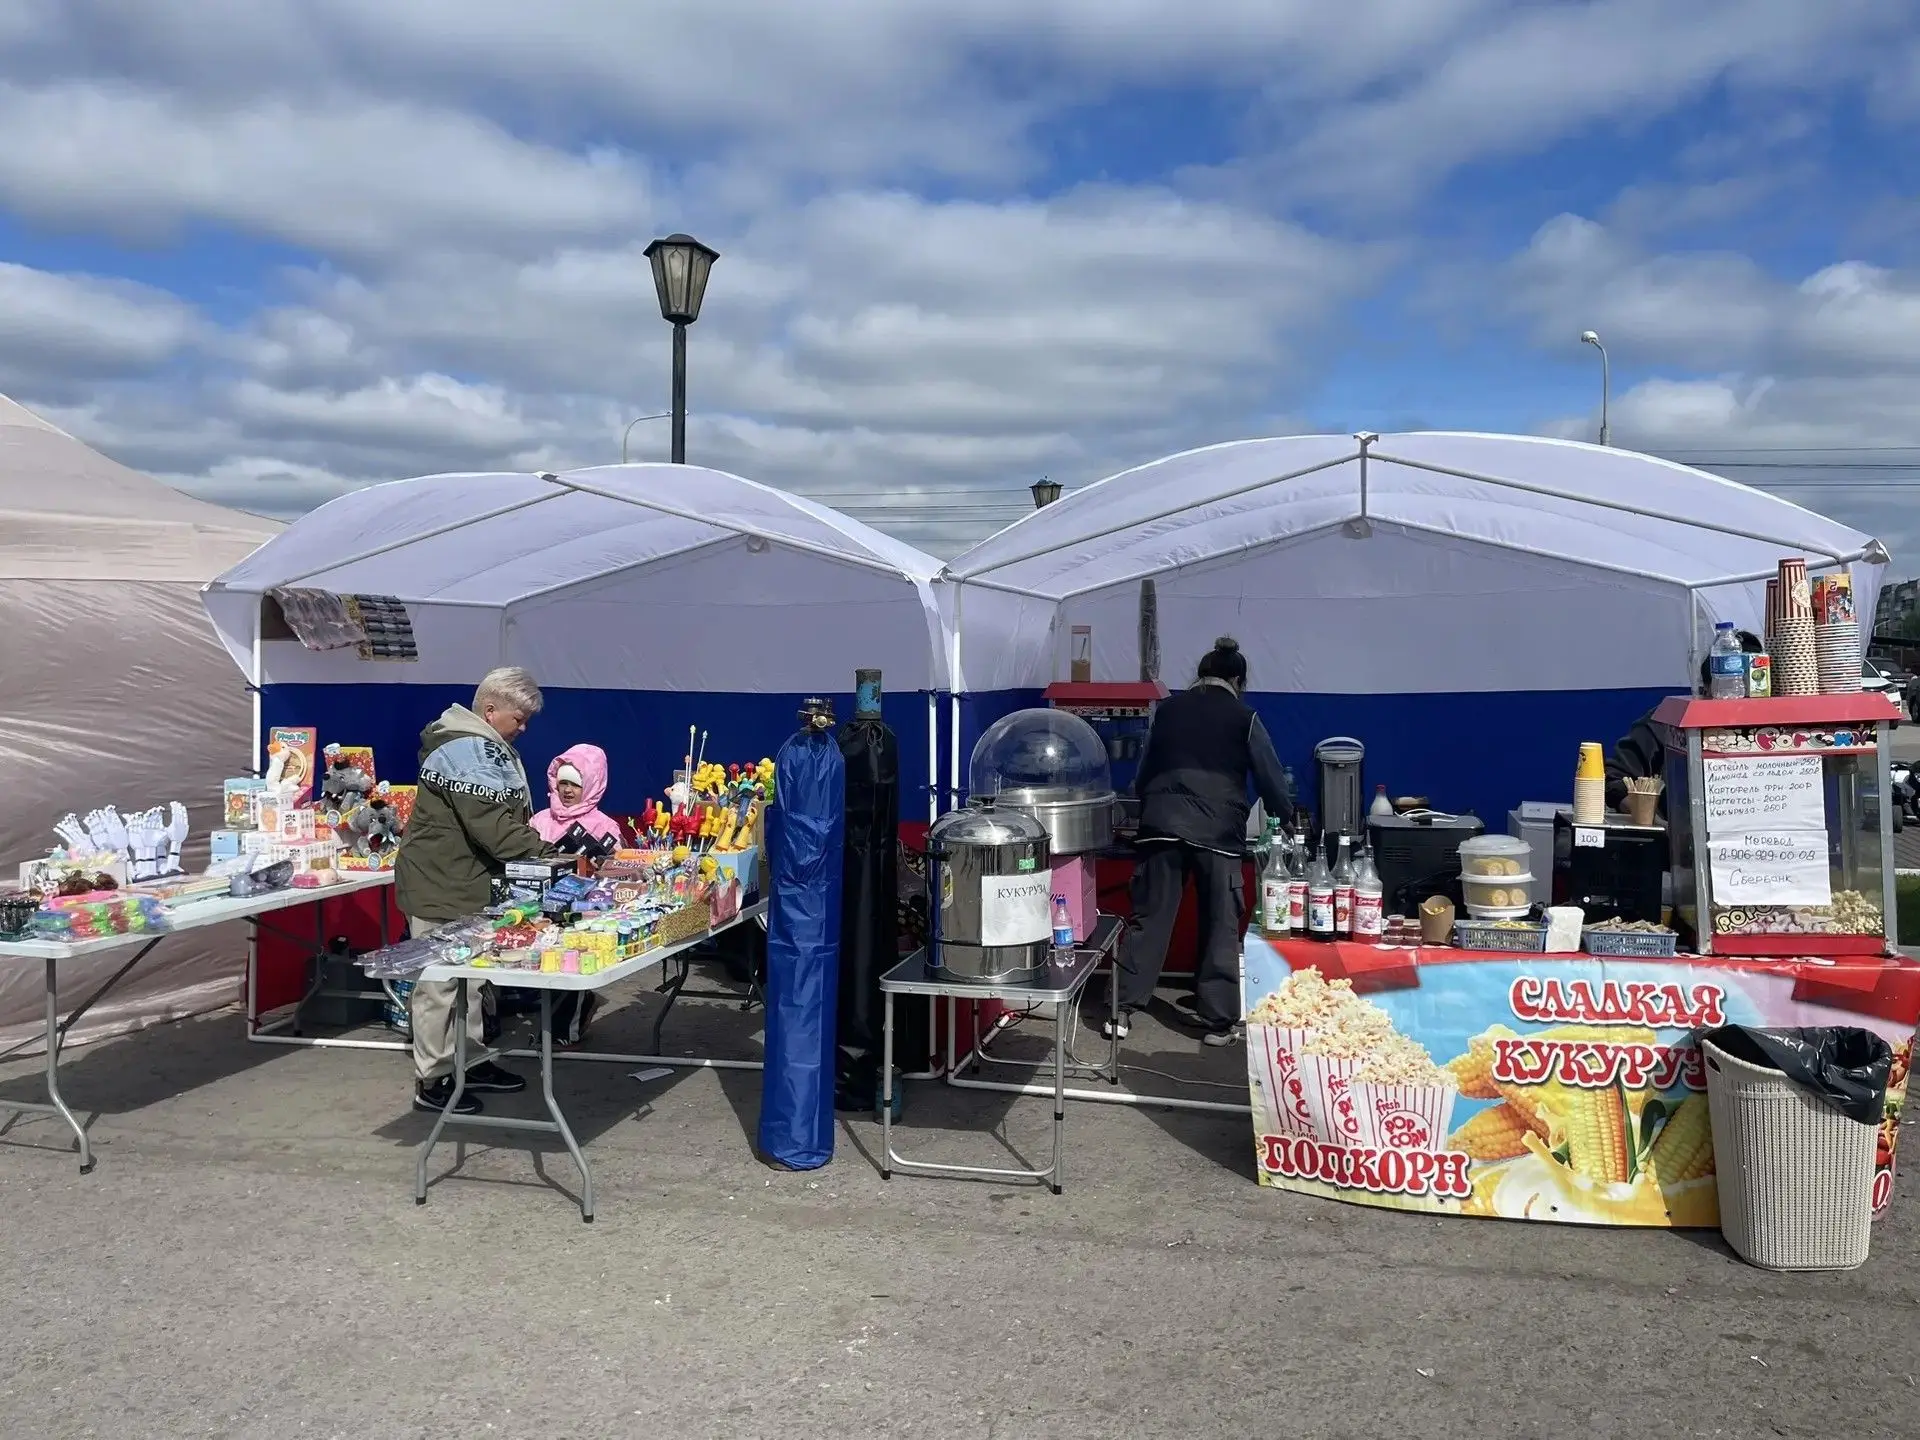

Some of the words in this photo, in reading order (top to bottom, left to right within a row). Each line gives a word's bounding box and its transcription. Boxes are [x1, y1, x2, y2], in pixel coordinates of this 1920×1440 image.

[449, 780, 472, 794] LOVE
[472, 784, 496, 801] LOVE
[1581, 834, 1598, 844] 100
[1729, 868, 1794, 886] Сбербанк
[997, 884, 1047, 898] КУКУРУЗА
[1511, 978, 1722, 1026] СЛАДКАЯ
[1494, 1039, 1708, 1087] КУКУРУЗ
[1375, 1098, 1401, 1115] fresh
[1384, 1115, 1416, 1135] POP
[1389, 1128, 1428, 1148] CORN
[1262, 1135, 1471, 1195] ПОПКОРН
